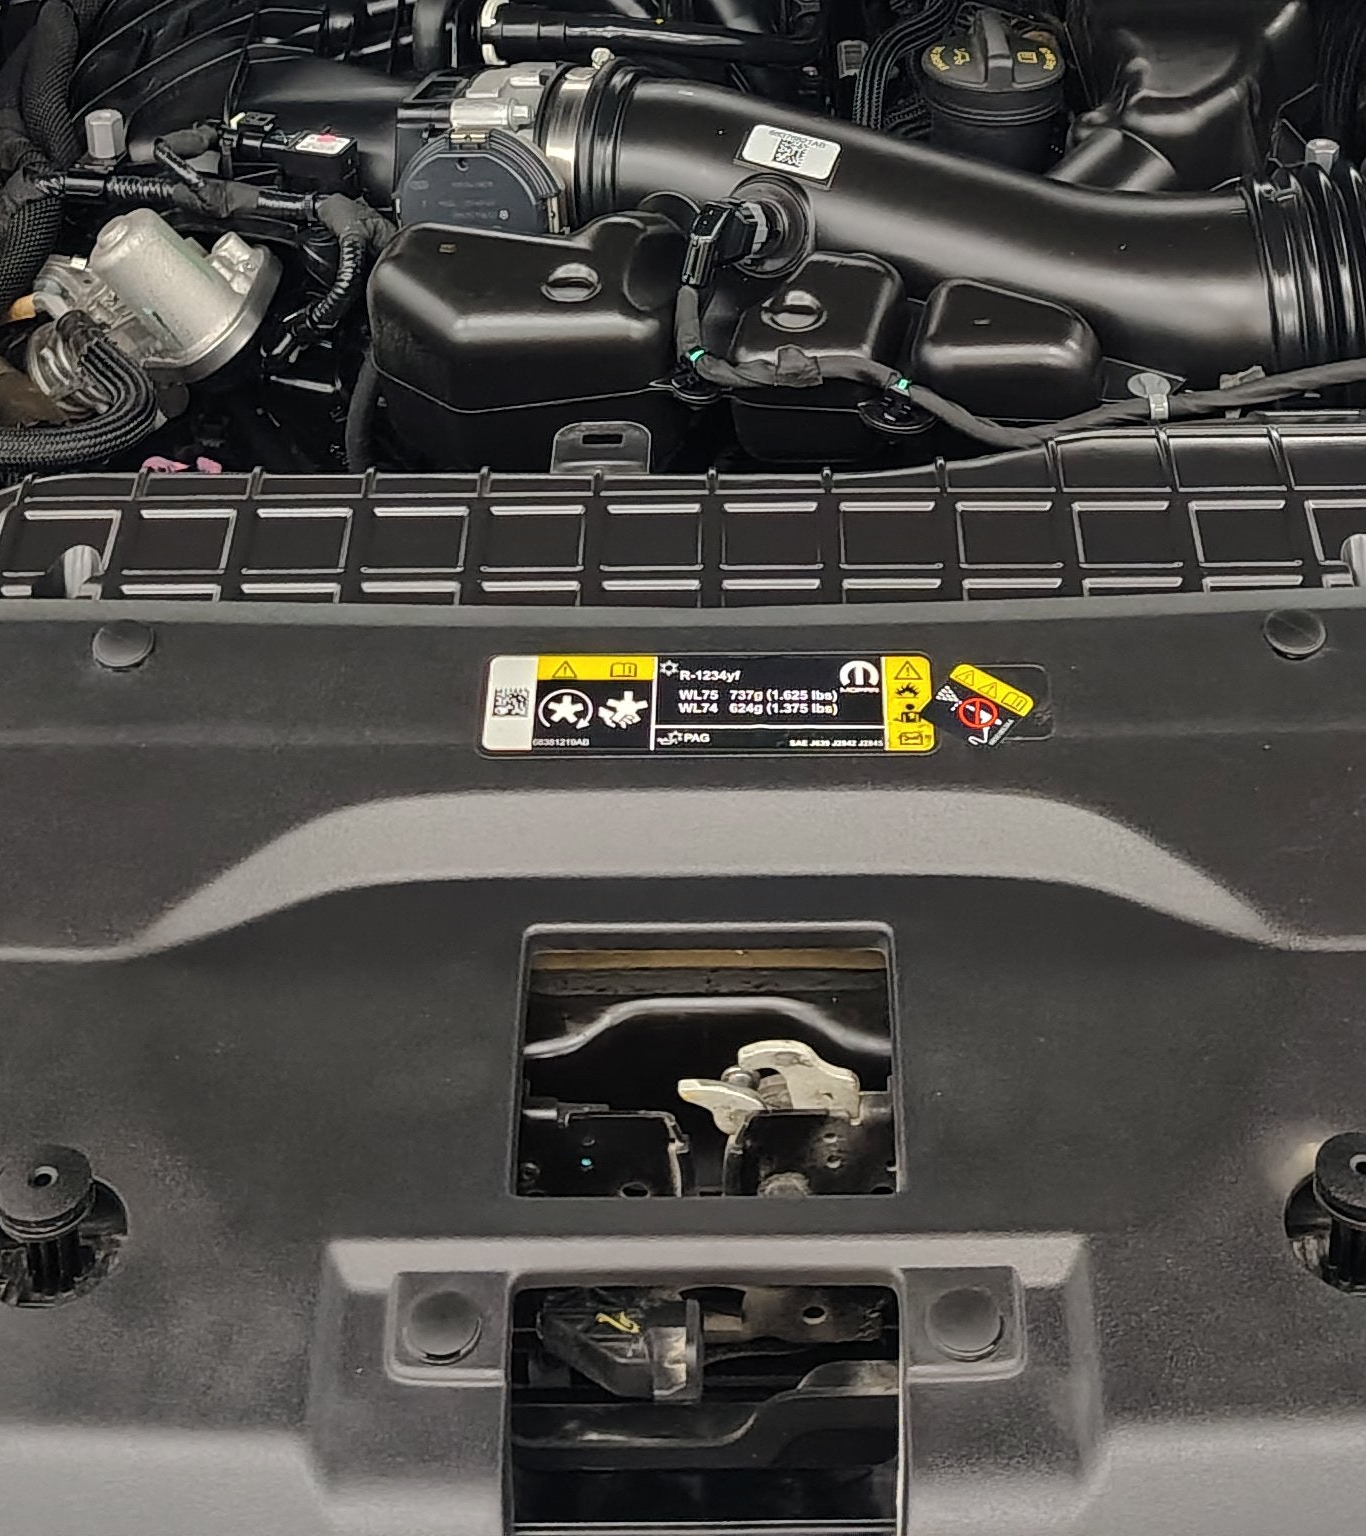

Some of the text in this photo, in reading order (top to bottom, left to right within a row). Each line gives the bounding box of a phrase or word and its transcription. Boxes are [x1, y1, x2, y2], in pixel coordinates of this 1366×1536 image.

[680, 670, 742, 683] R-1234yf
[679, 689, 838, 702] WL75 737g (1.625 lbs)
[678, 702, 839, 715] WL74 624g (1.375 lbs)
[684, 733, 710, 743] PAG
[789, 739, 809, 747] SAE
